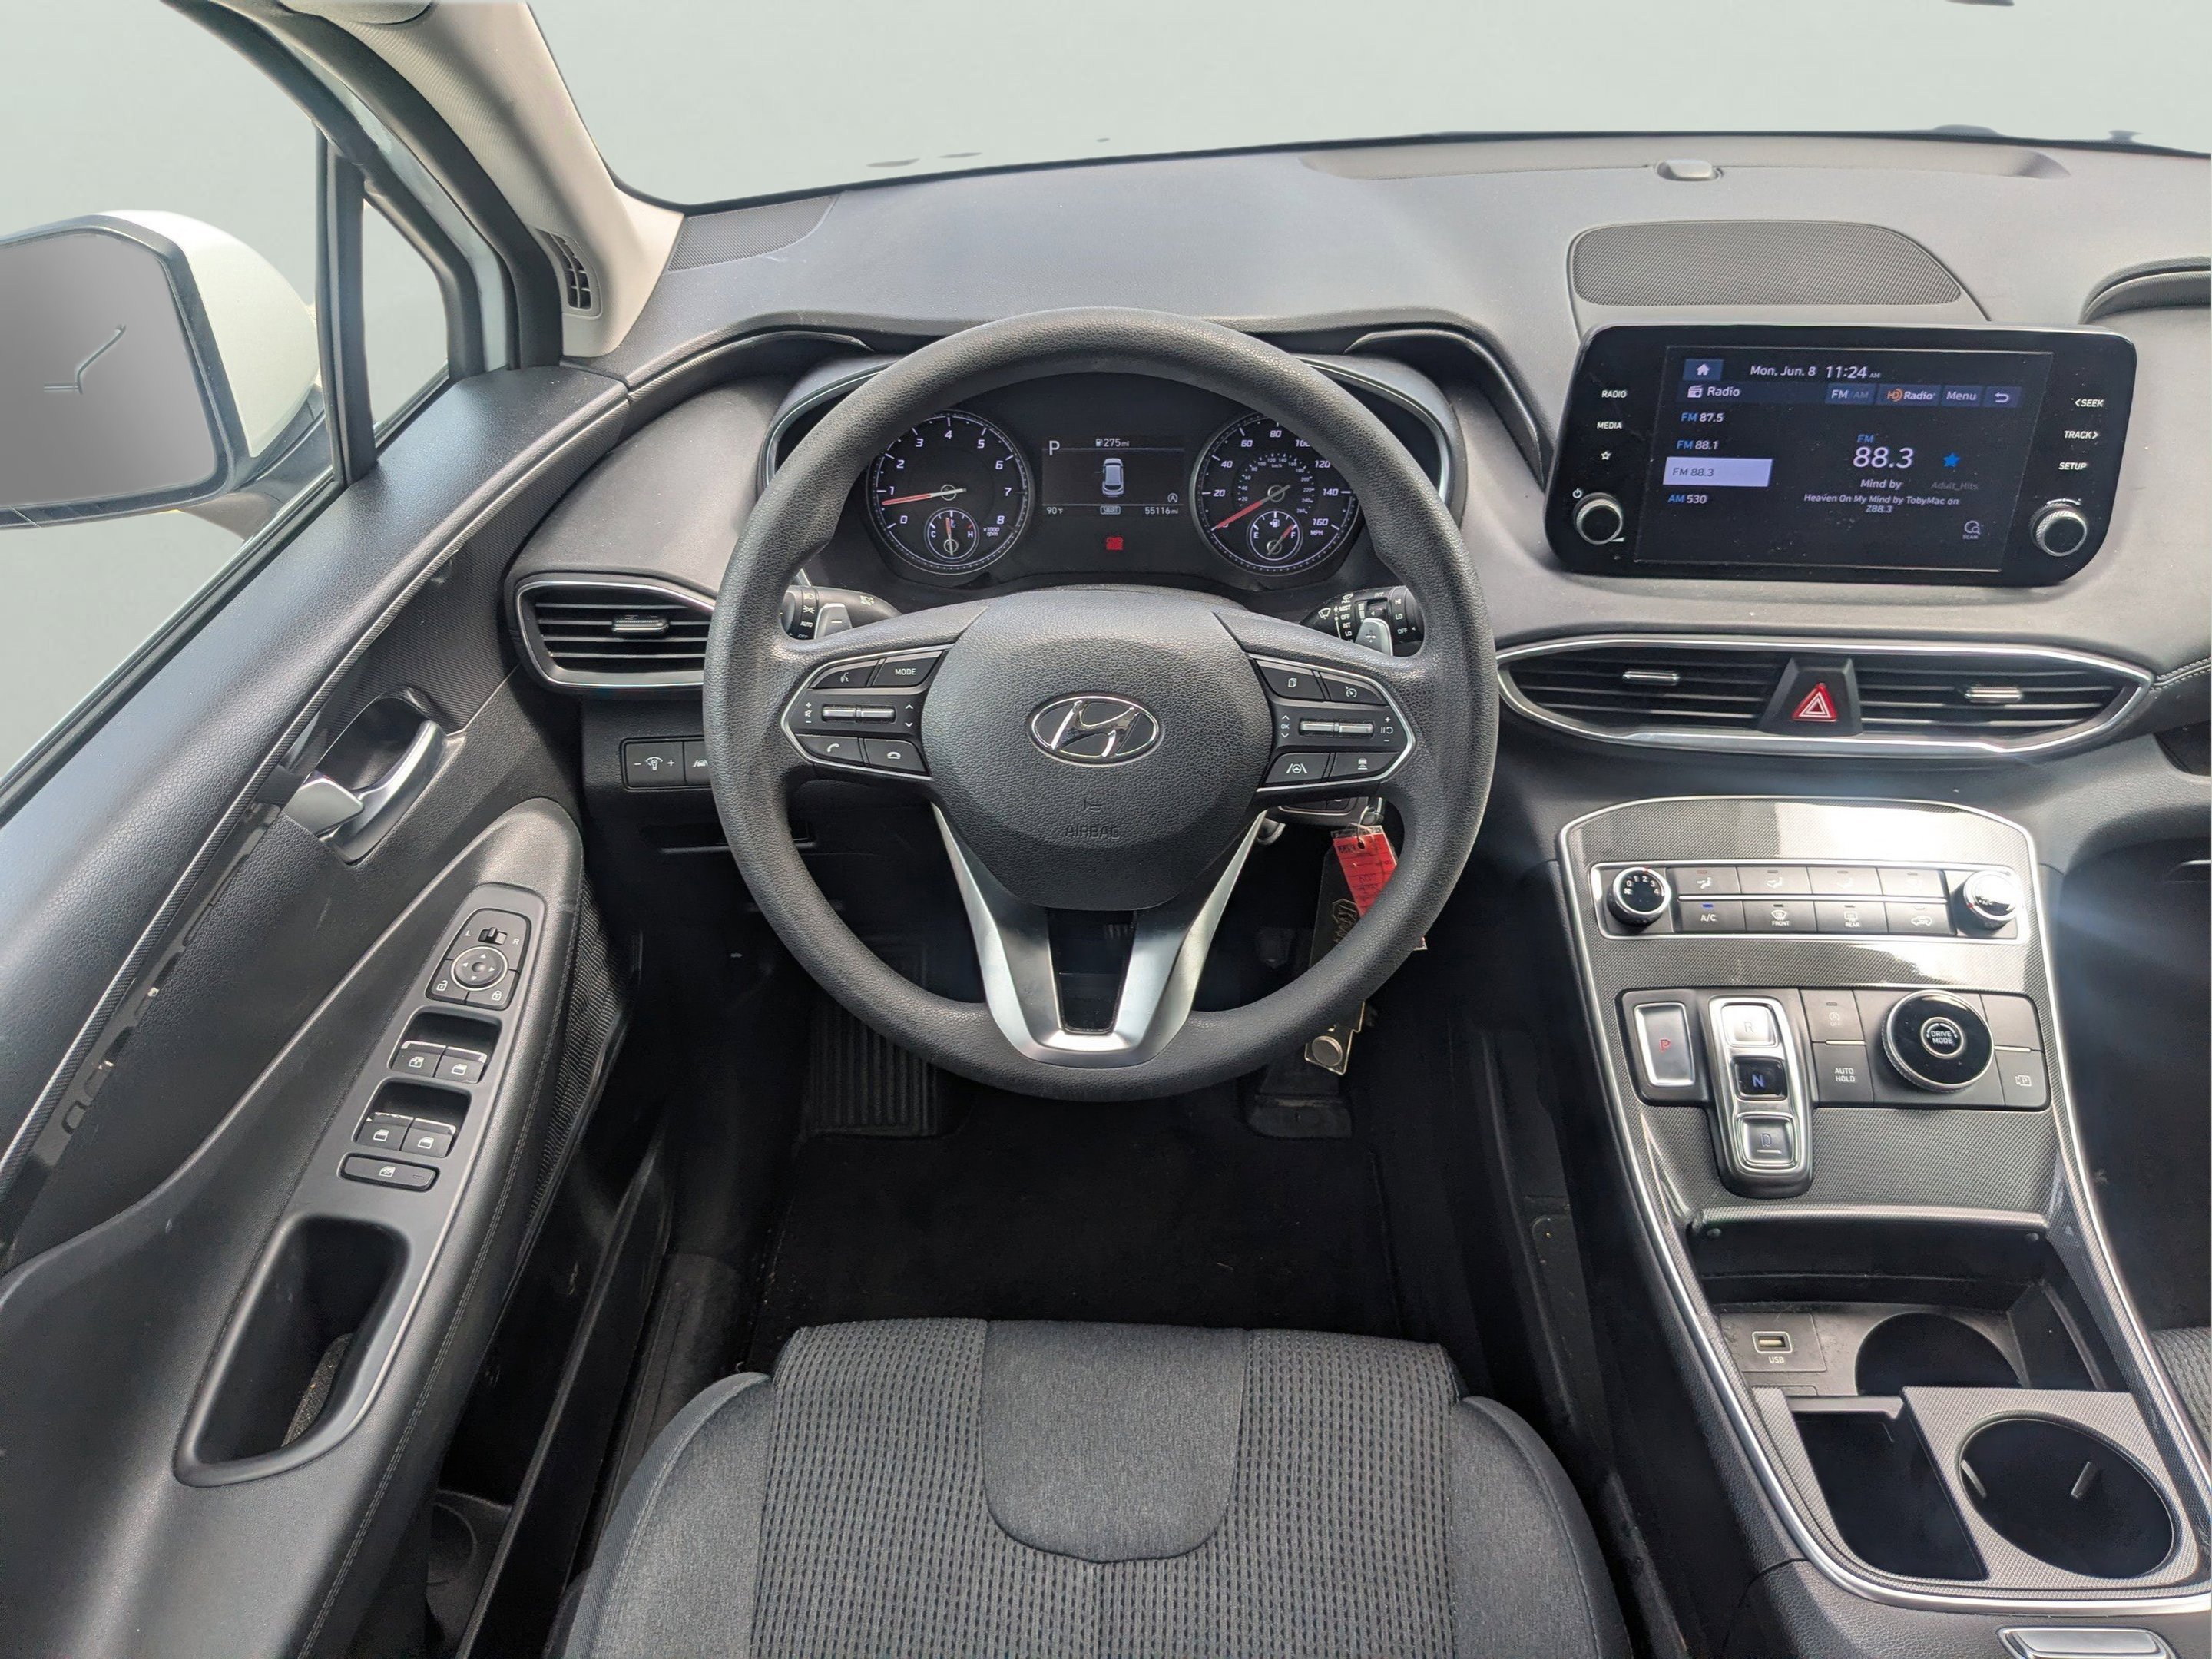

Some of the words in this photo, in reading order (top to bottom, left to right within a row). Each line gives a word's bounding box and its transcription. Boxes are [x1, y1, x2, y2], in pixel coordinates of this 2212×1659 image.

[1750, 366, 1777, 376] Mon,
[1780, 366, 1805, 376] Jun.
[1807, 366, 1816, 376] 8
[1826, 366, 1868, 379] 11:24
[1601, 389, 1628, 398] RADIO
[1707, 386, 1741, 397] Radio
[1946, 391, 1977, 401] Menu
[1681, 412, 1697, 422] FM
[1699, 413, 1724, 422] 87.5
[945, 430, 952, 439] 4
[1857, 434, 1874, 443] FM
[916, 439, 924, 447] 3
[977, 439, 985, 449] 5
[1049, 440, 1060, 455] P
[1677, 440, 1694, 449] FM
[1694, 441, 1719, 450] 88.1
[1853, 447, 1914, 469] 88.3
[896, 460, 905, 469] 2
[995, 461, 1004, 470] 6
[1672, 468, 1687, 476] FM
[1690, 468, 1714, 477] 88.3
[1860, 478, 1886, 488] Mind
[1889, 478, 1902, 490] by
[889, 486, 895, 495] 1
[1005, 488, 1012, 496] 7
[1668, 495, 1684, 503] AM
[1686, 495, 1707, 504] 530
[1804, 494, 1836, 503] Heaven
[1839, 495, 1852, 503] On
[1853, 495, 1866, 504] My
[1869, 495, 1891, 504] Mind
[1892, 495, 1904, 505] by
[1906, 496, 1945, 505] TobyMac
[900, 515, 908, 524] 0
[997, 515, 1005, 525] 8
[1065, 825, 1121, 839] AIRBAG
[1744, 1022, 1754, 1032] R
[1659, 1039, 1671, 1052] P
[1753, 1075, 1766, 1087] N
[1760, 1133, 1773, 1147] D
